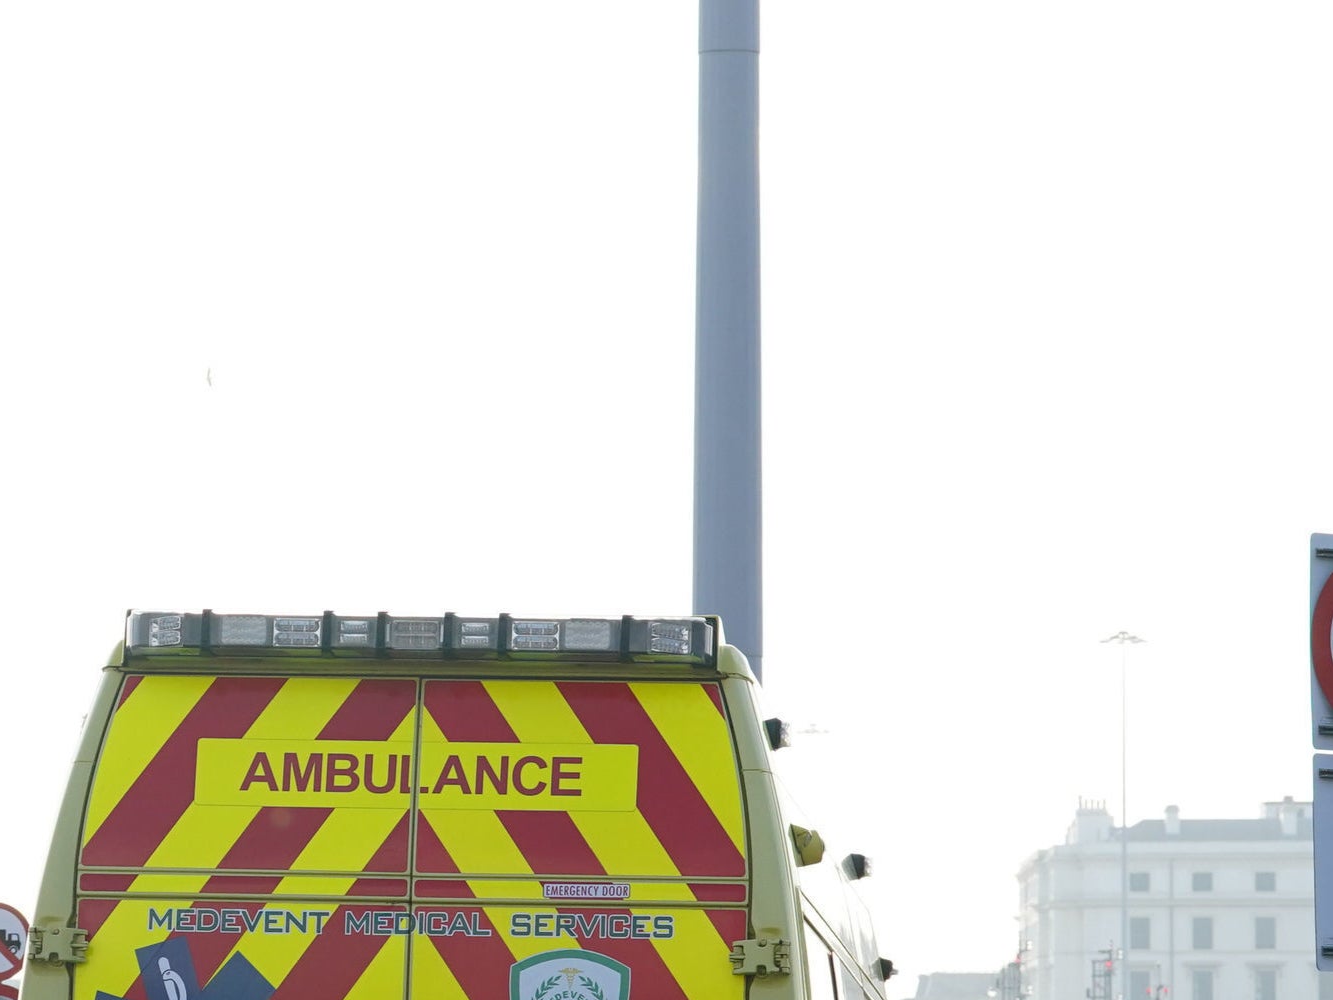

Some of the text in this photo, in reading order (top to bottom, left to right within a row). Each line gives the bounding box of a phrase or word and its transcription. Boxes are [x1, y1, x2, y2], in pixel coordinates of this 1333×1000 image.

[239, 751, 583, 797] AMBULANCE
[546, 885, 629, 897] EMERGENCY DOOR
[148, 908, 674, 939] MEDEVENT MEDICAL SERVICES
